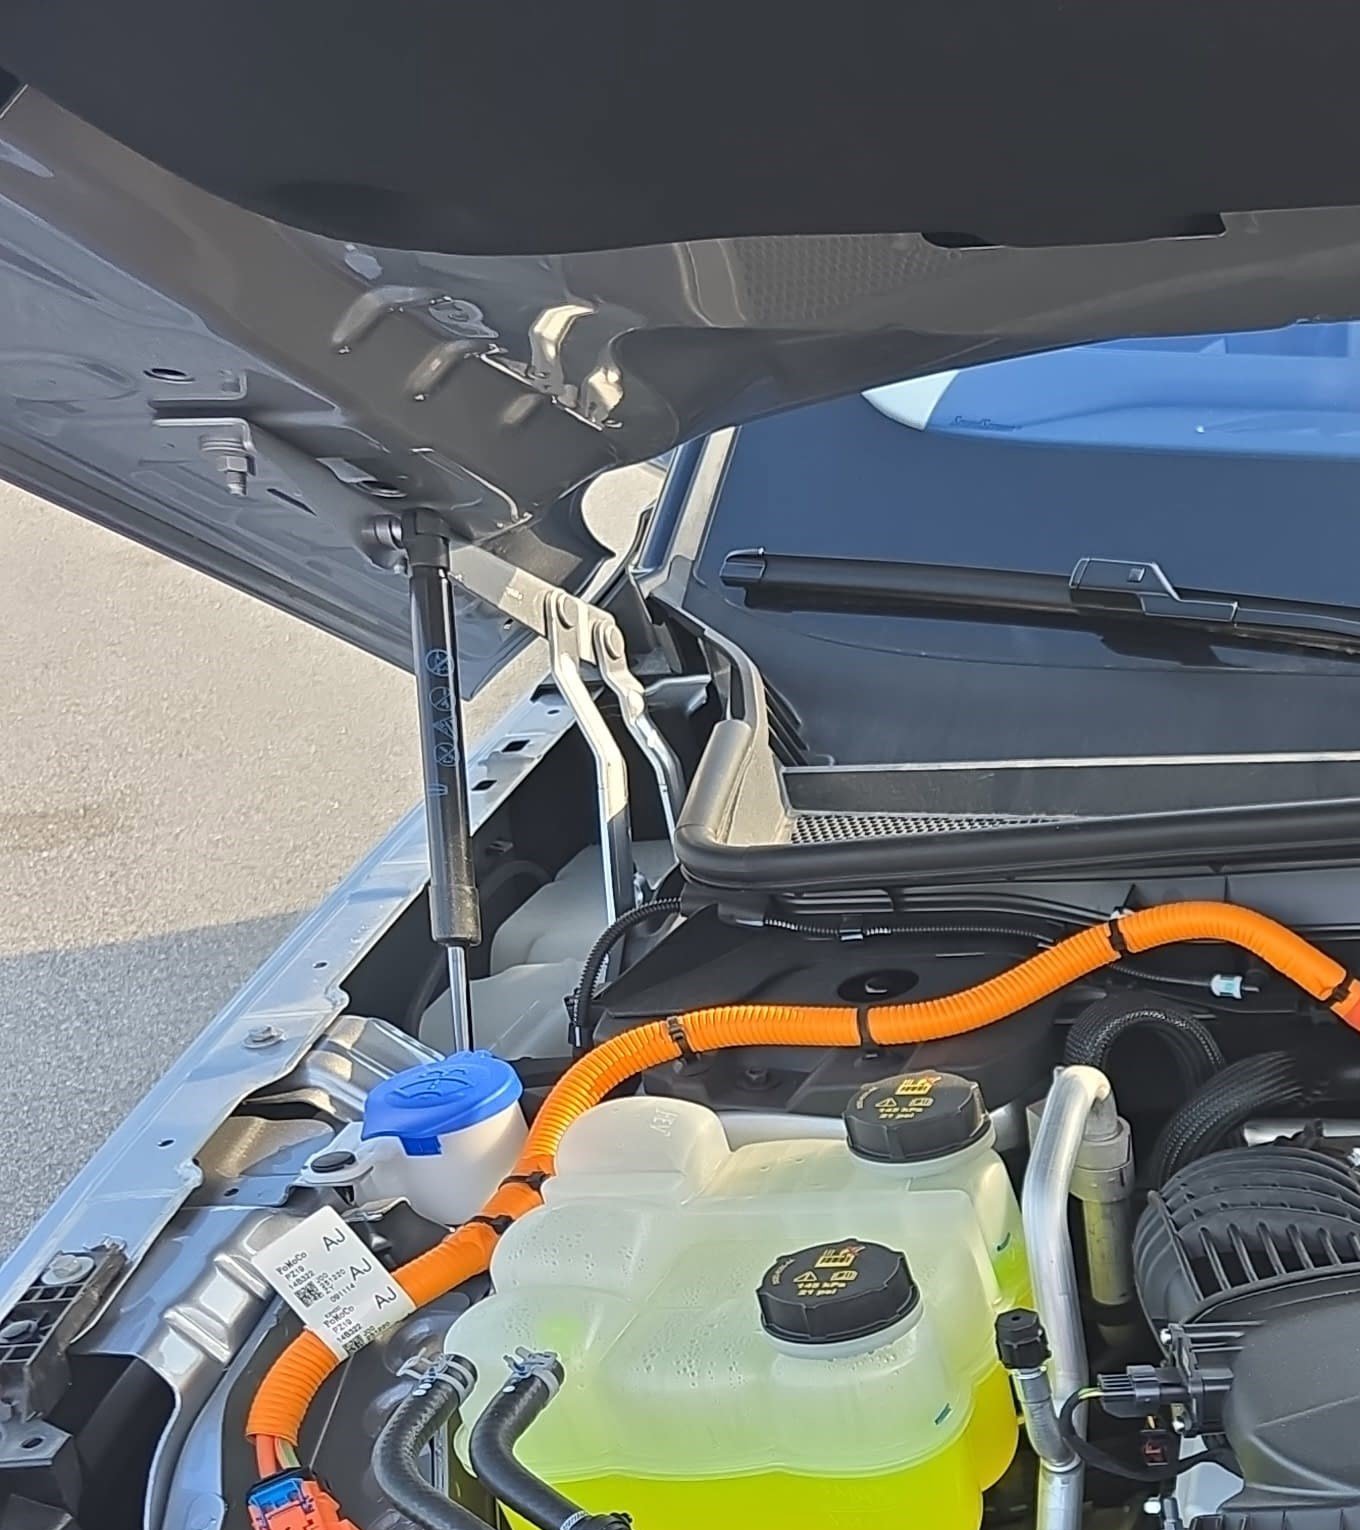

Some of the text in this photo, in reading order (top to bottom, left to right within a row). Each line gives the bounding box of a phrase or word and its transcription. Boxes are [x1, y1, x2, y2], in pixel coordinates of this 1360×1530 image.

[321, 1228, 347, 1252] AJ
[275, 1251, 308, 1275] FoMoCo
[349, 1257, 373, 1281] AJ
[374, 1286, 397, 1310] AJ
[323, 1305, 355, 1329] FoMoCo
